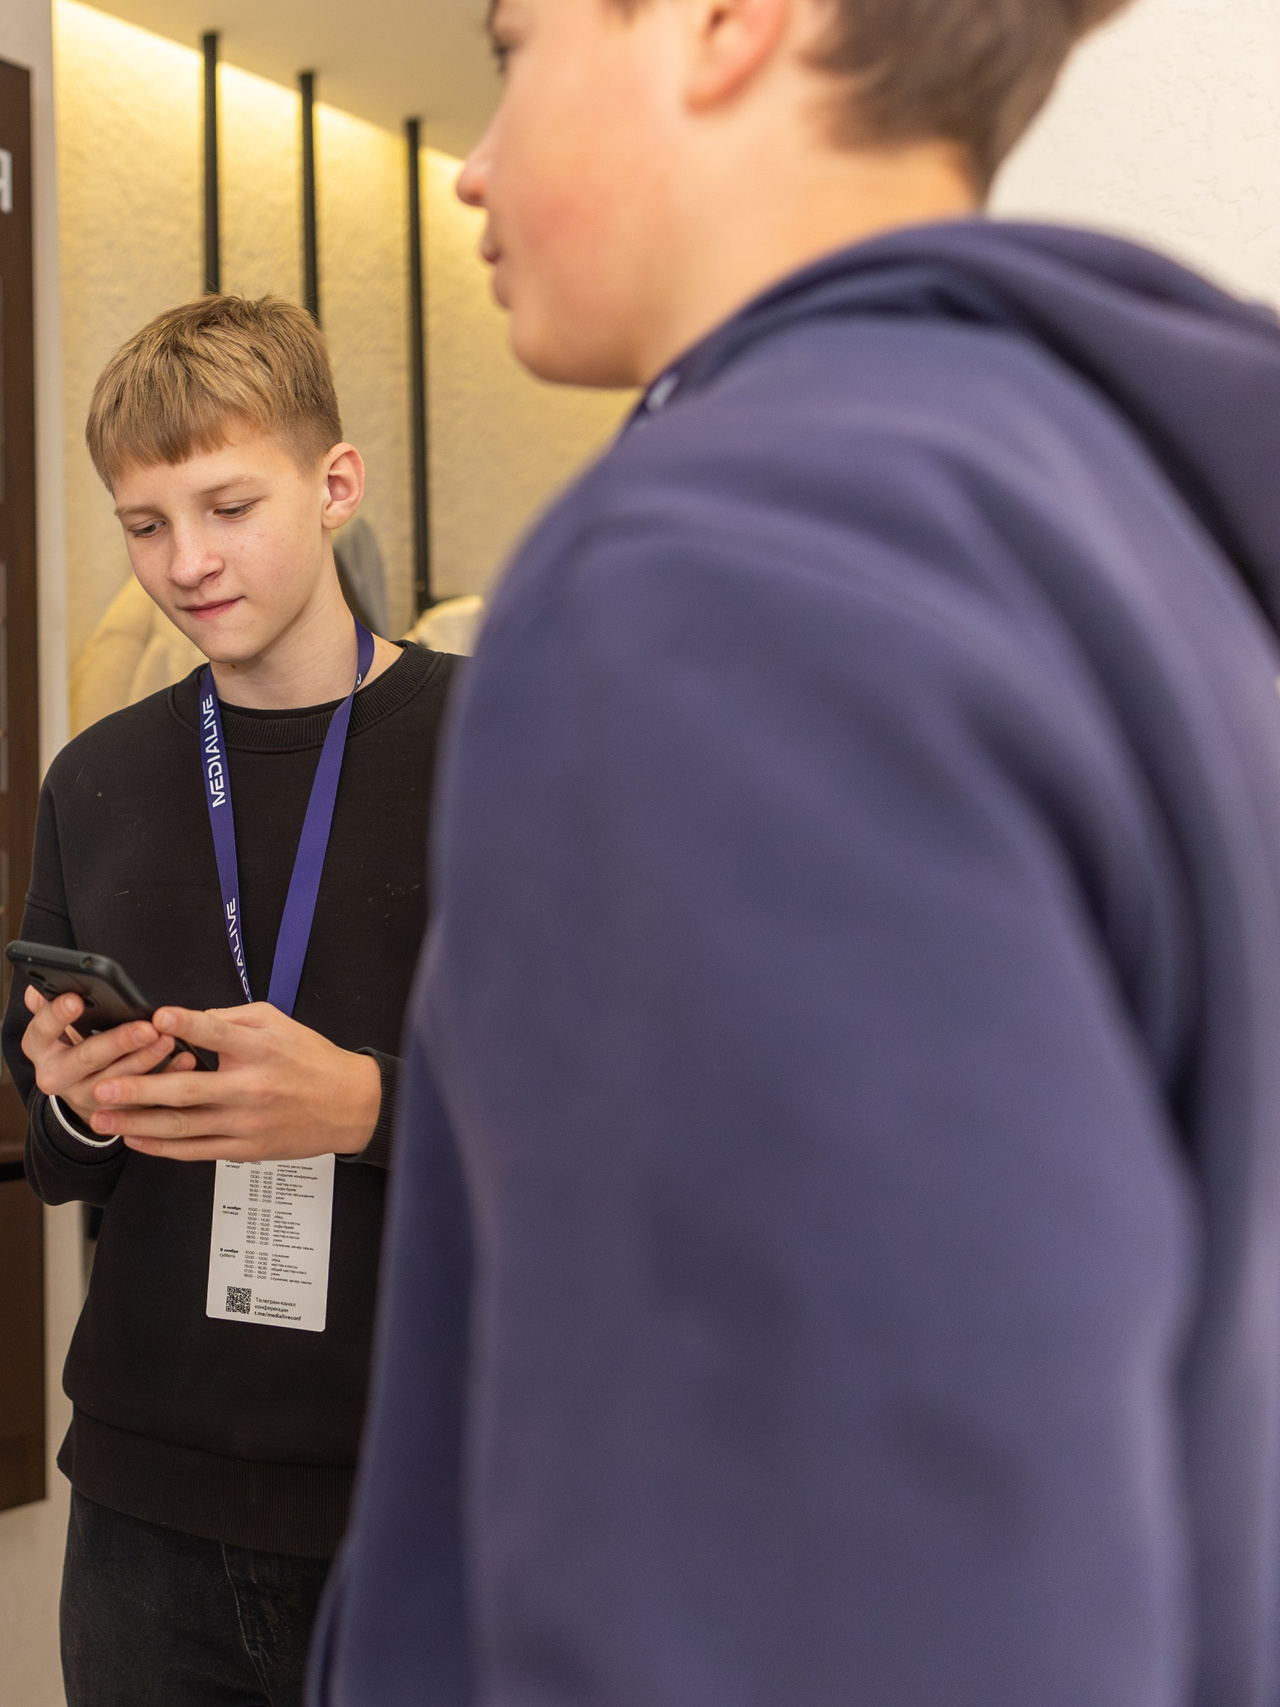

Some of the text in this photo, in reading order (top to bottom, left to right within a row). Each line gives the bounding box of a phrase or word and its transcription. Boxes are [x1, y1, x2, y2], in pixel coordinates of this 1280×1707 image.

[202, 694, 226, 808] MEDIALIVE
[256, 1297, 296, 1307] Телеграм-канал
[254, 1311, 301, 1321] t.me/medialiveconf
